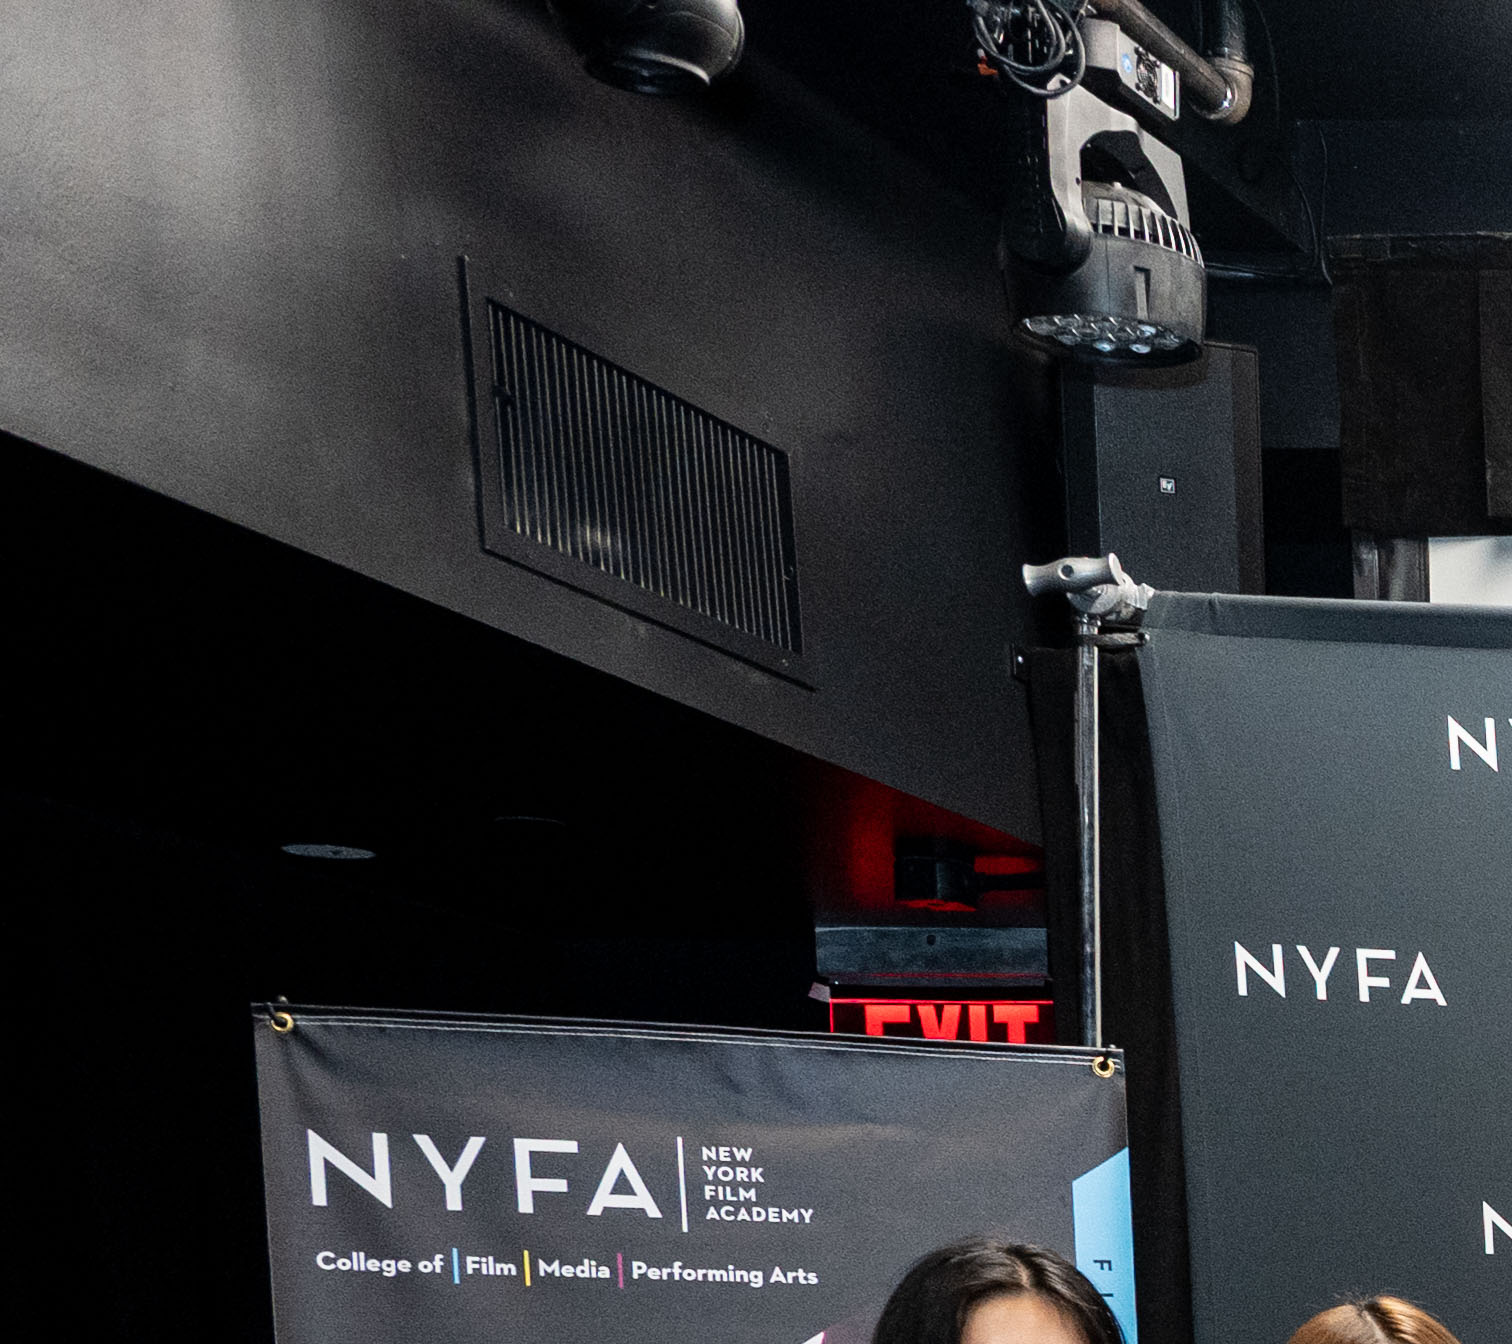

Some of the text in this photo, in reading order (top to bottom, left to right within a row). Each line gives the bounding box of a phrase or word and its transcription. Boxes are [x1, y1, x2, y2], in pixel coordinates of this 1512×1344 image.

[1234, 941, 1448, 1007] NYFA
[701, 1146, 753, 1162] NEW
[307, 1129, 663, 1219] NYFA
[702, 1165, 765, 1183] YORK
[704, 1185, 757, 1202] FILM
[705, 1205, 814, 1224] ACADEMY
[315, 1250, 819, 1288] College of Film Media Performing Arts
